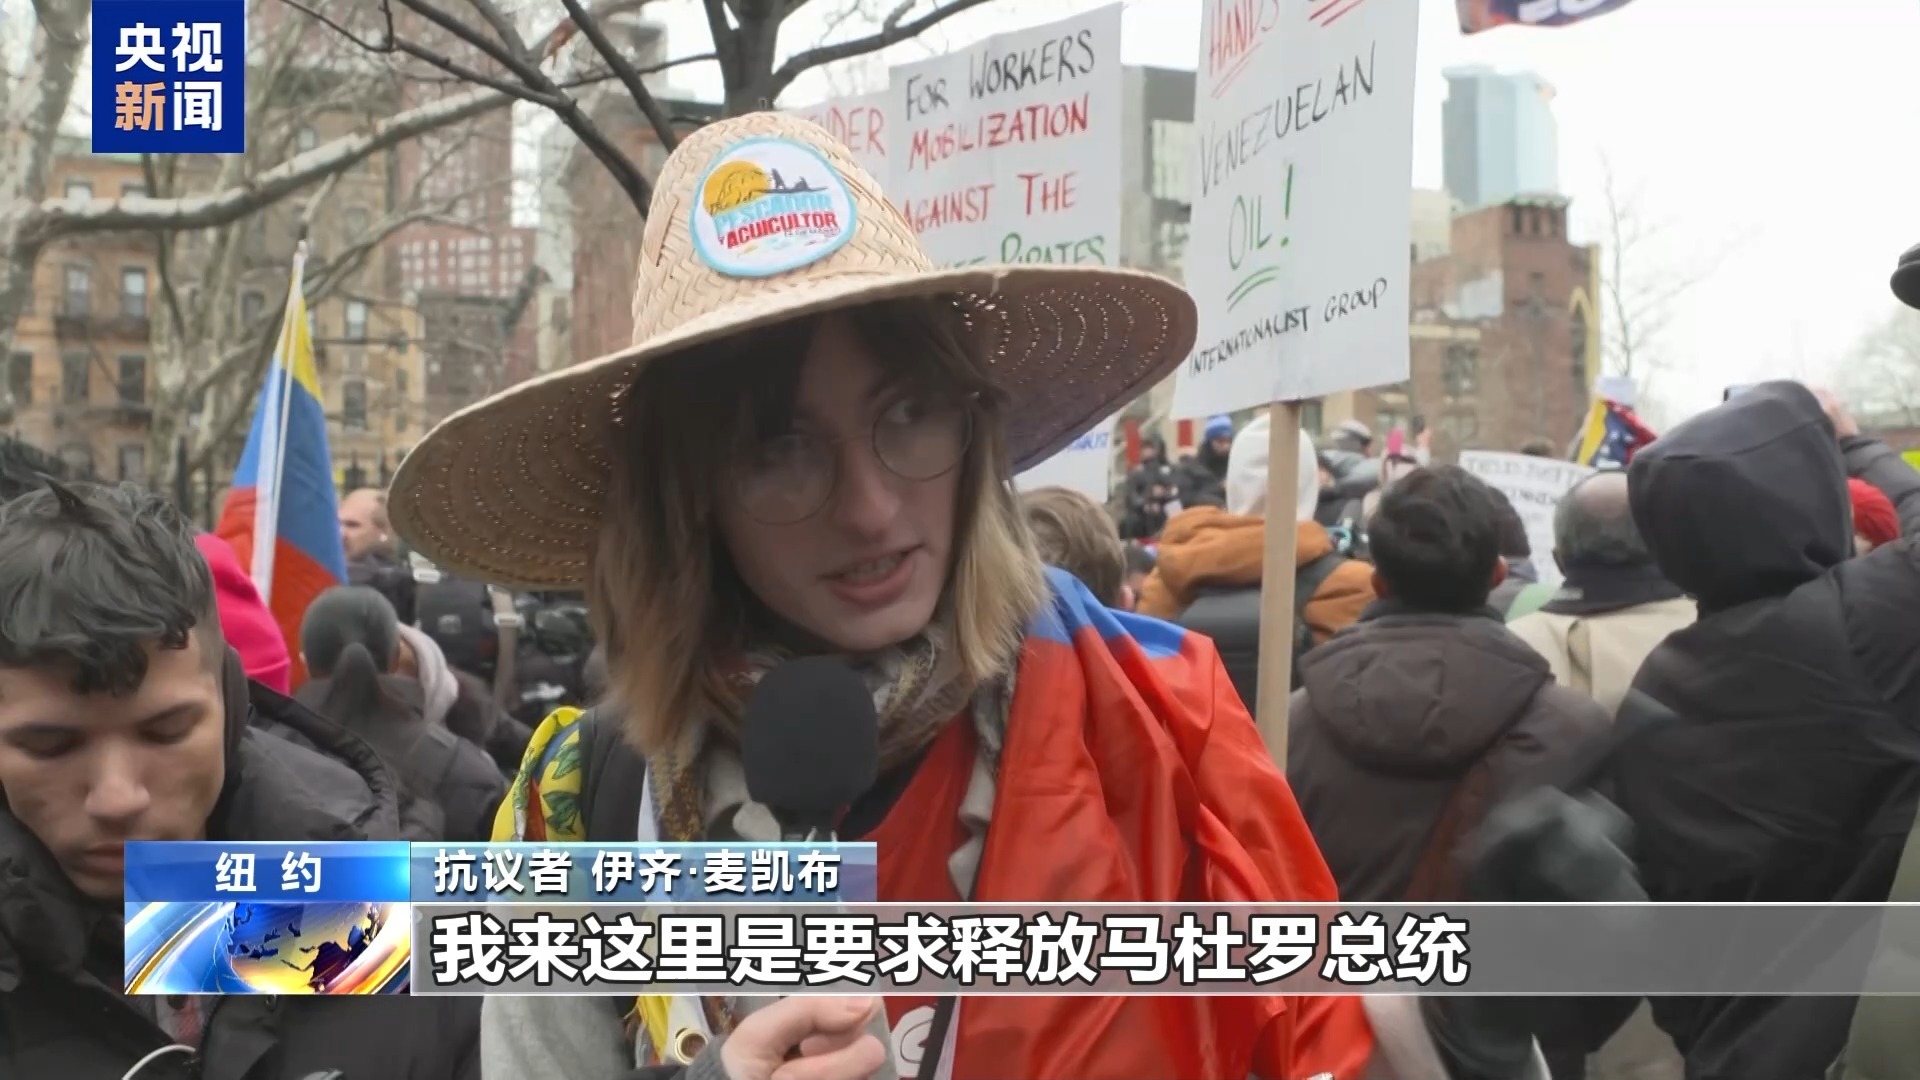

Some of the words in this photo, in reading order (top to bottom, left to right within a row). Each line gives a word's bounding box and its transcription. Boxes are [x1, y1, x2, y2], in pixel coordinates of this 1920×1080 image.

[906, 74, 951, 121] FOR
[968, 29, 1096, 100] WORKERS
[907, 92, 1090, 172] MOBILIZATION
[1201, 40, 1376, 197] VENEZUELAN
[727, 210, 840, 250] ACUICULTOR
[902, 184, 995, 237] AGAINST
[1017, 171, 1079, 216] THE
[1228, 163, 1294, 270] OIL!
[1323, 277, 1388, 323] GROUP
